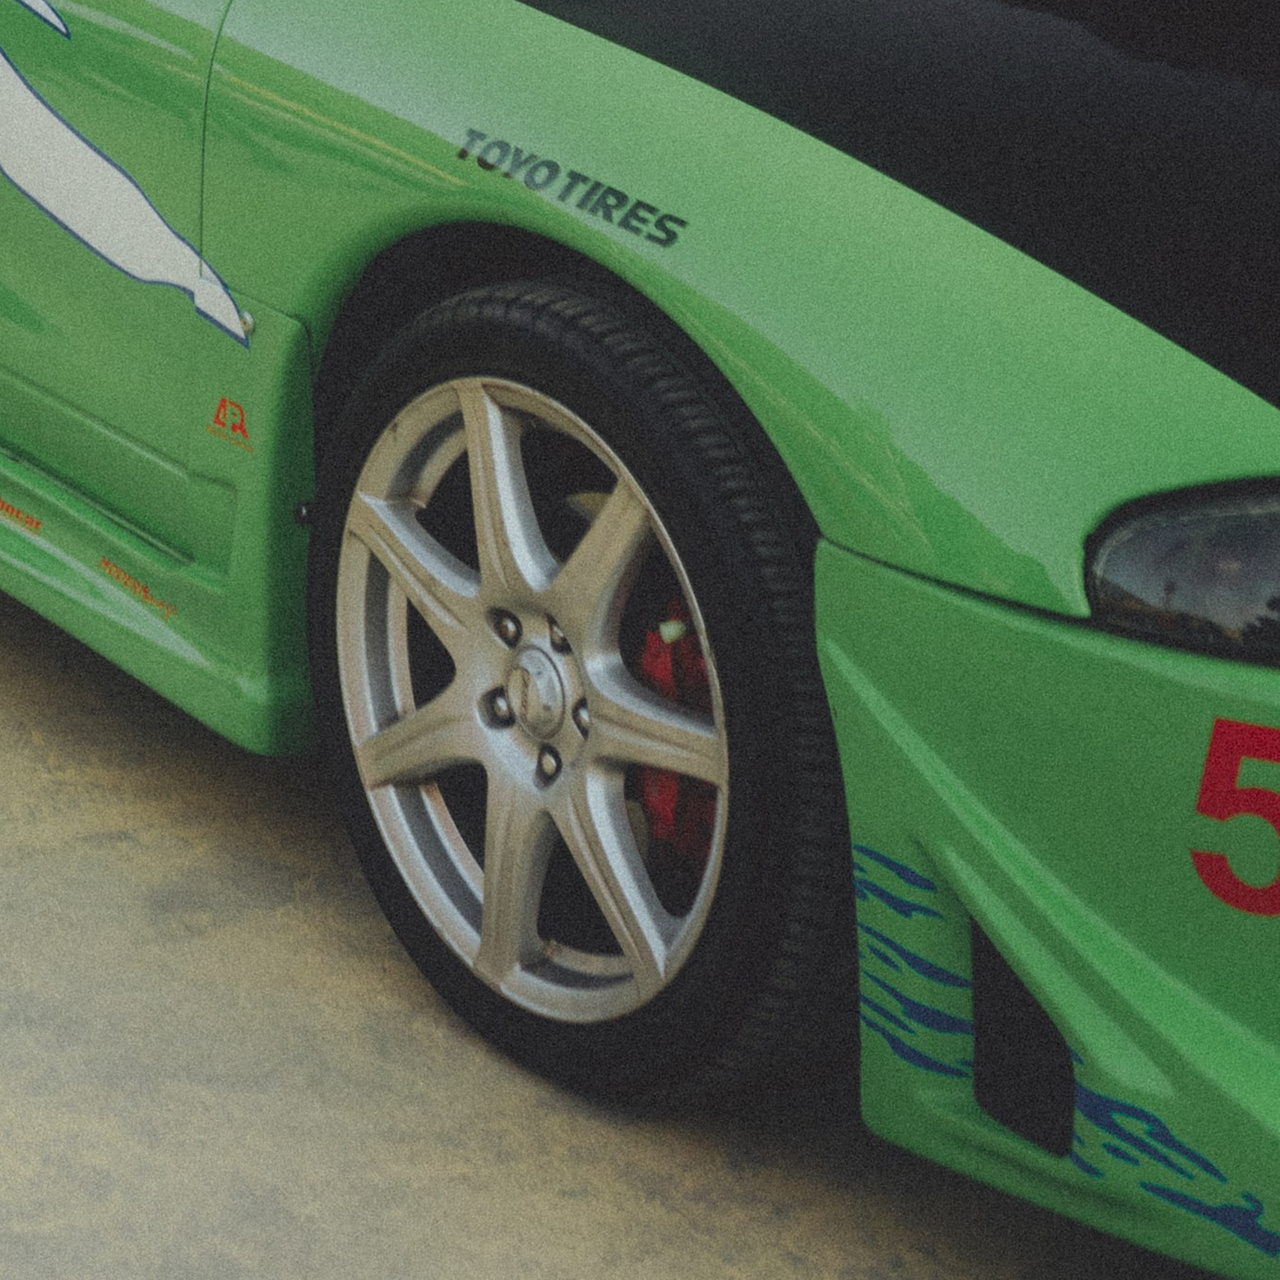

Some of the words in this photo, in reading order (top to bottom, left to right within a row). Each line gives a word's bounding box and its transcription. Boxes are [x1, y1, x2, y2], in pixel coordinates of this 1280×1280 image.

[456, 127, 561, 191] TOYO
[556, 169, 690, 248] TIRES
[1190, 717, 1280, 919] 5
